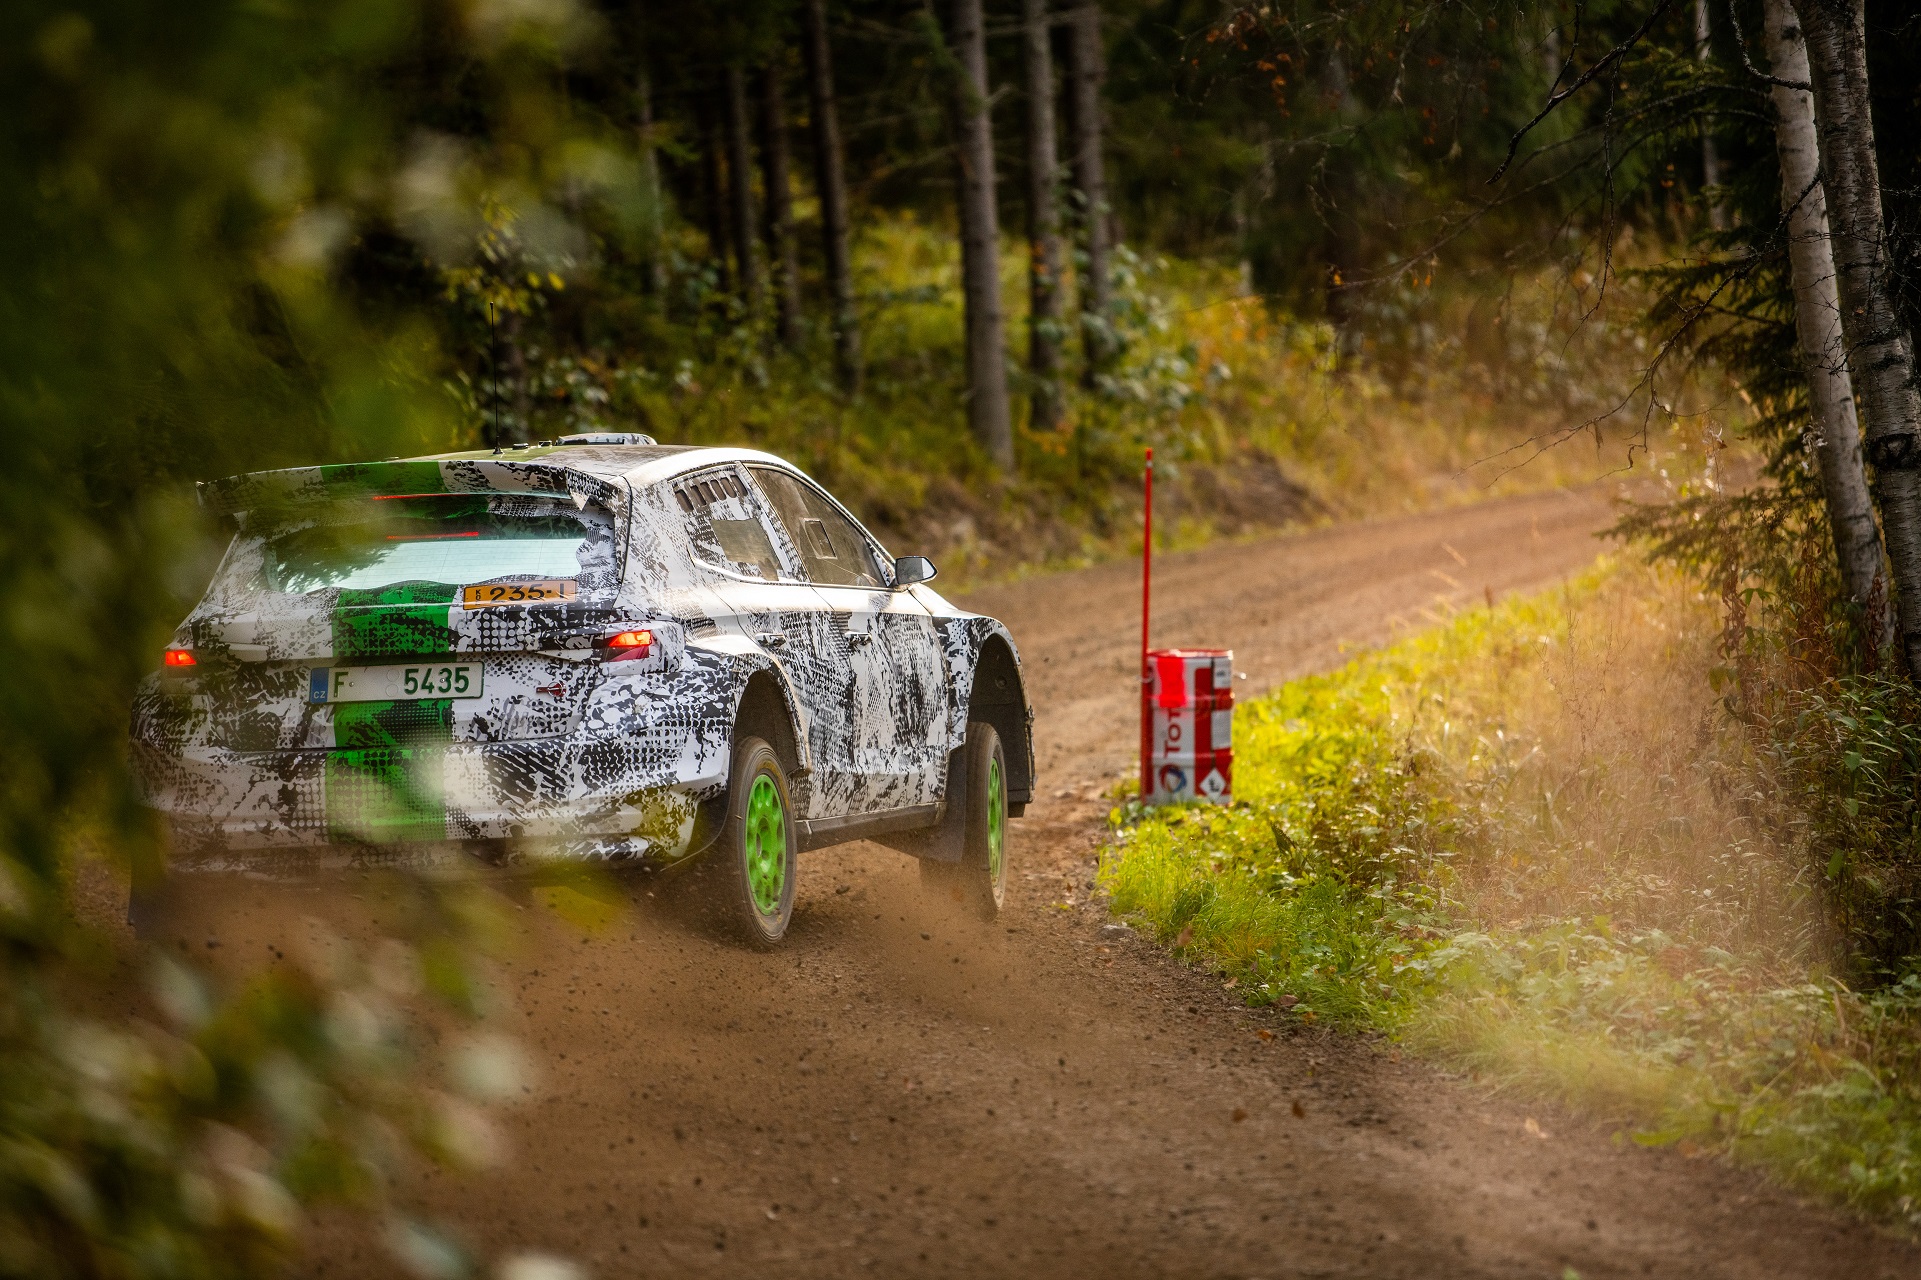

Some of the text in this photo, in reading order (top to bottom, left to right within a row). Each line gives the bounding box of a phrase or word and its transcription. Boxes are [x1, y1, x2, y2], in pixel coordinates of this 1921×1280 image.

[313, 690, 326, 699] CZ
[333, 666, 470, 698] F 5435
[1164, 707, 1181, 758] TOT
